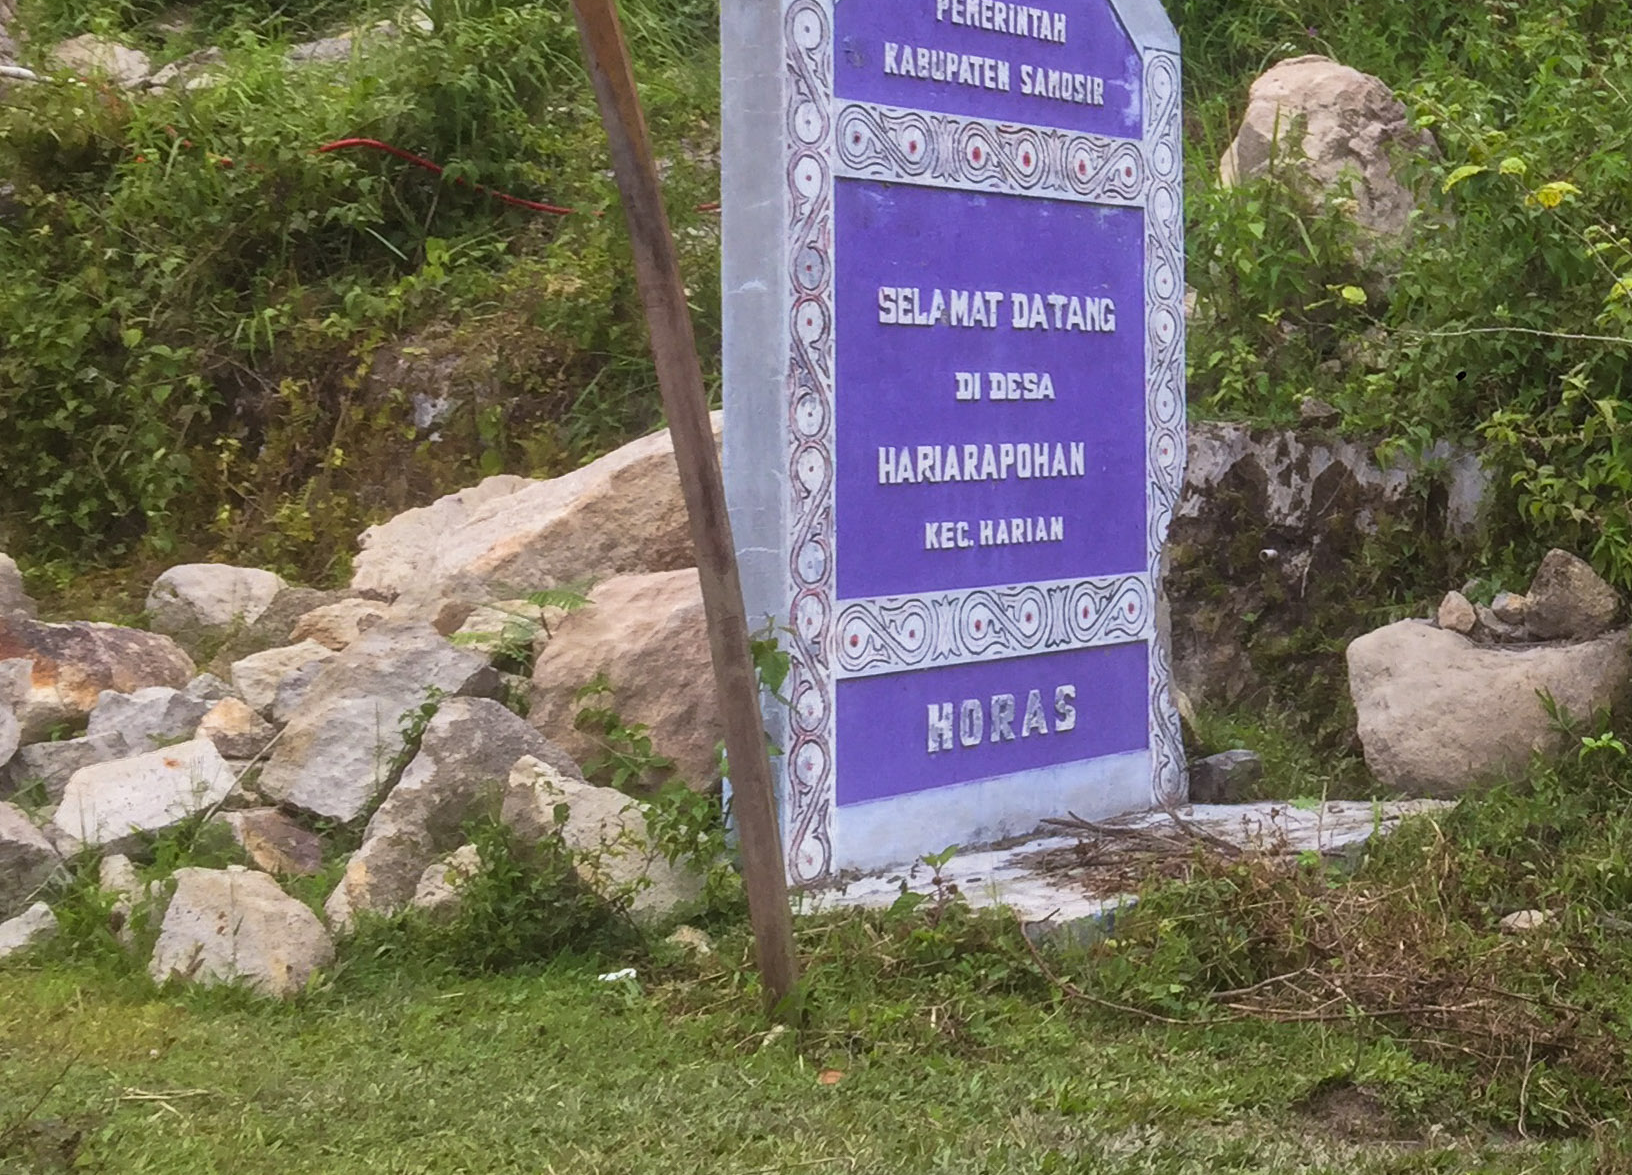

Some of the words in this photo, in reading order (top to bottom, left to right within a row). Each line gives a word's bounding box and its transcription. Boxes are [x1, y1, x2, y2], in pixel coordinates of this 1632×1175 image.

[884, 41, 1010, 92] KABUPATEN
[1020, 64, 1104, 106] SAMOSIR
[878, 286, 1003, 327] SELAMAT
[1011, 292, 1116, 332] DATANG
[955, 372, 981, 401] DI
[989, 372, 1055, 400] DESA
[878, 442, 1085, 484] HARIARAPOHAN
[980, 516, 1064, 547] HARIAN
[926, 684, 1077, 753] HORAS
